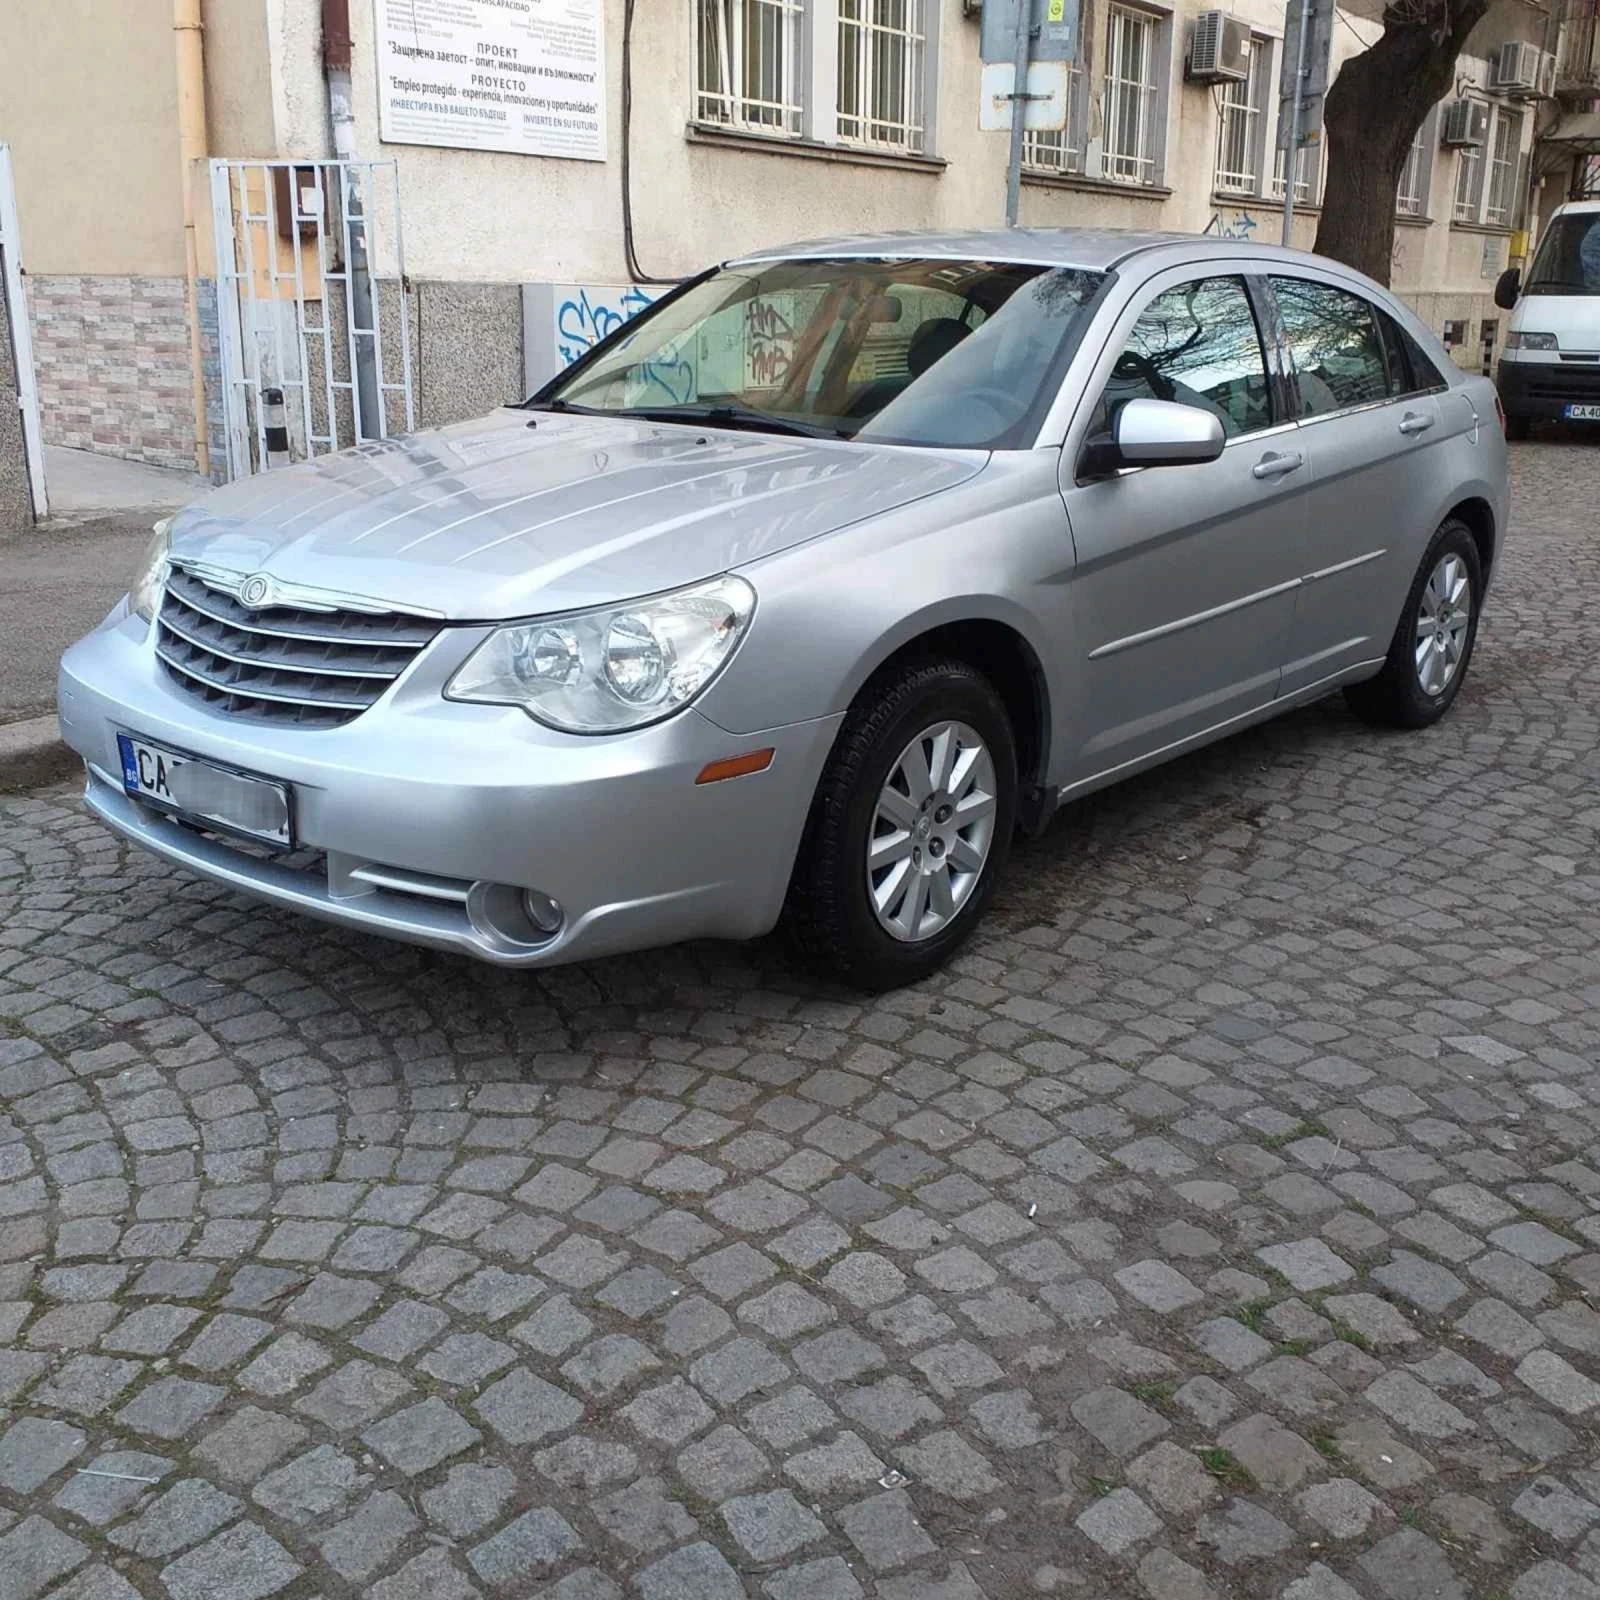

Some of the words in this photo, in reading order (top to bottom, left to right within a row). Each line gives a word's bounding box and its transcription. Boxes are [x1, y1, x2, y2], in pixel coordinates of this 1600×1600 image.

[477, 42, 518, 59] ПРОЕКТ
[436, 51, 467, 64] заетост
[475, 57, 497, 71] опит,
[498, 60, 537, 75] иновации
[538, 67, 543, 76] и
[471, 74, 526, 92] PROYECTO
[422, 83, 457, 98] protegido
[462, 87, 502, 104] experiencia,
[503, 91, 546, 108] innovaciones
[547, 99, 551, 111] y
[390, 98, 433, 112] ИНВЕСТИРА
[434, 103, 448, 114] ВЪВ
[450, 104, 478, 117] ВАШЕТО
[479, 108, 507, 121] БЪДЕЩЕ
[523, 114, 552, 127] INVIERTE
[553, 117, 563, 128] EN
[563, 119, 572, 129] SU
[572, 119, 598, 131] FUTURO
[126, 768, 137, 782] BG
